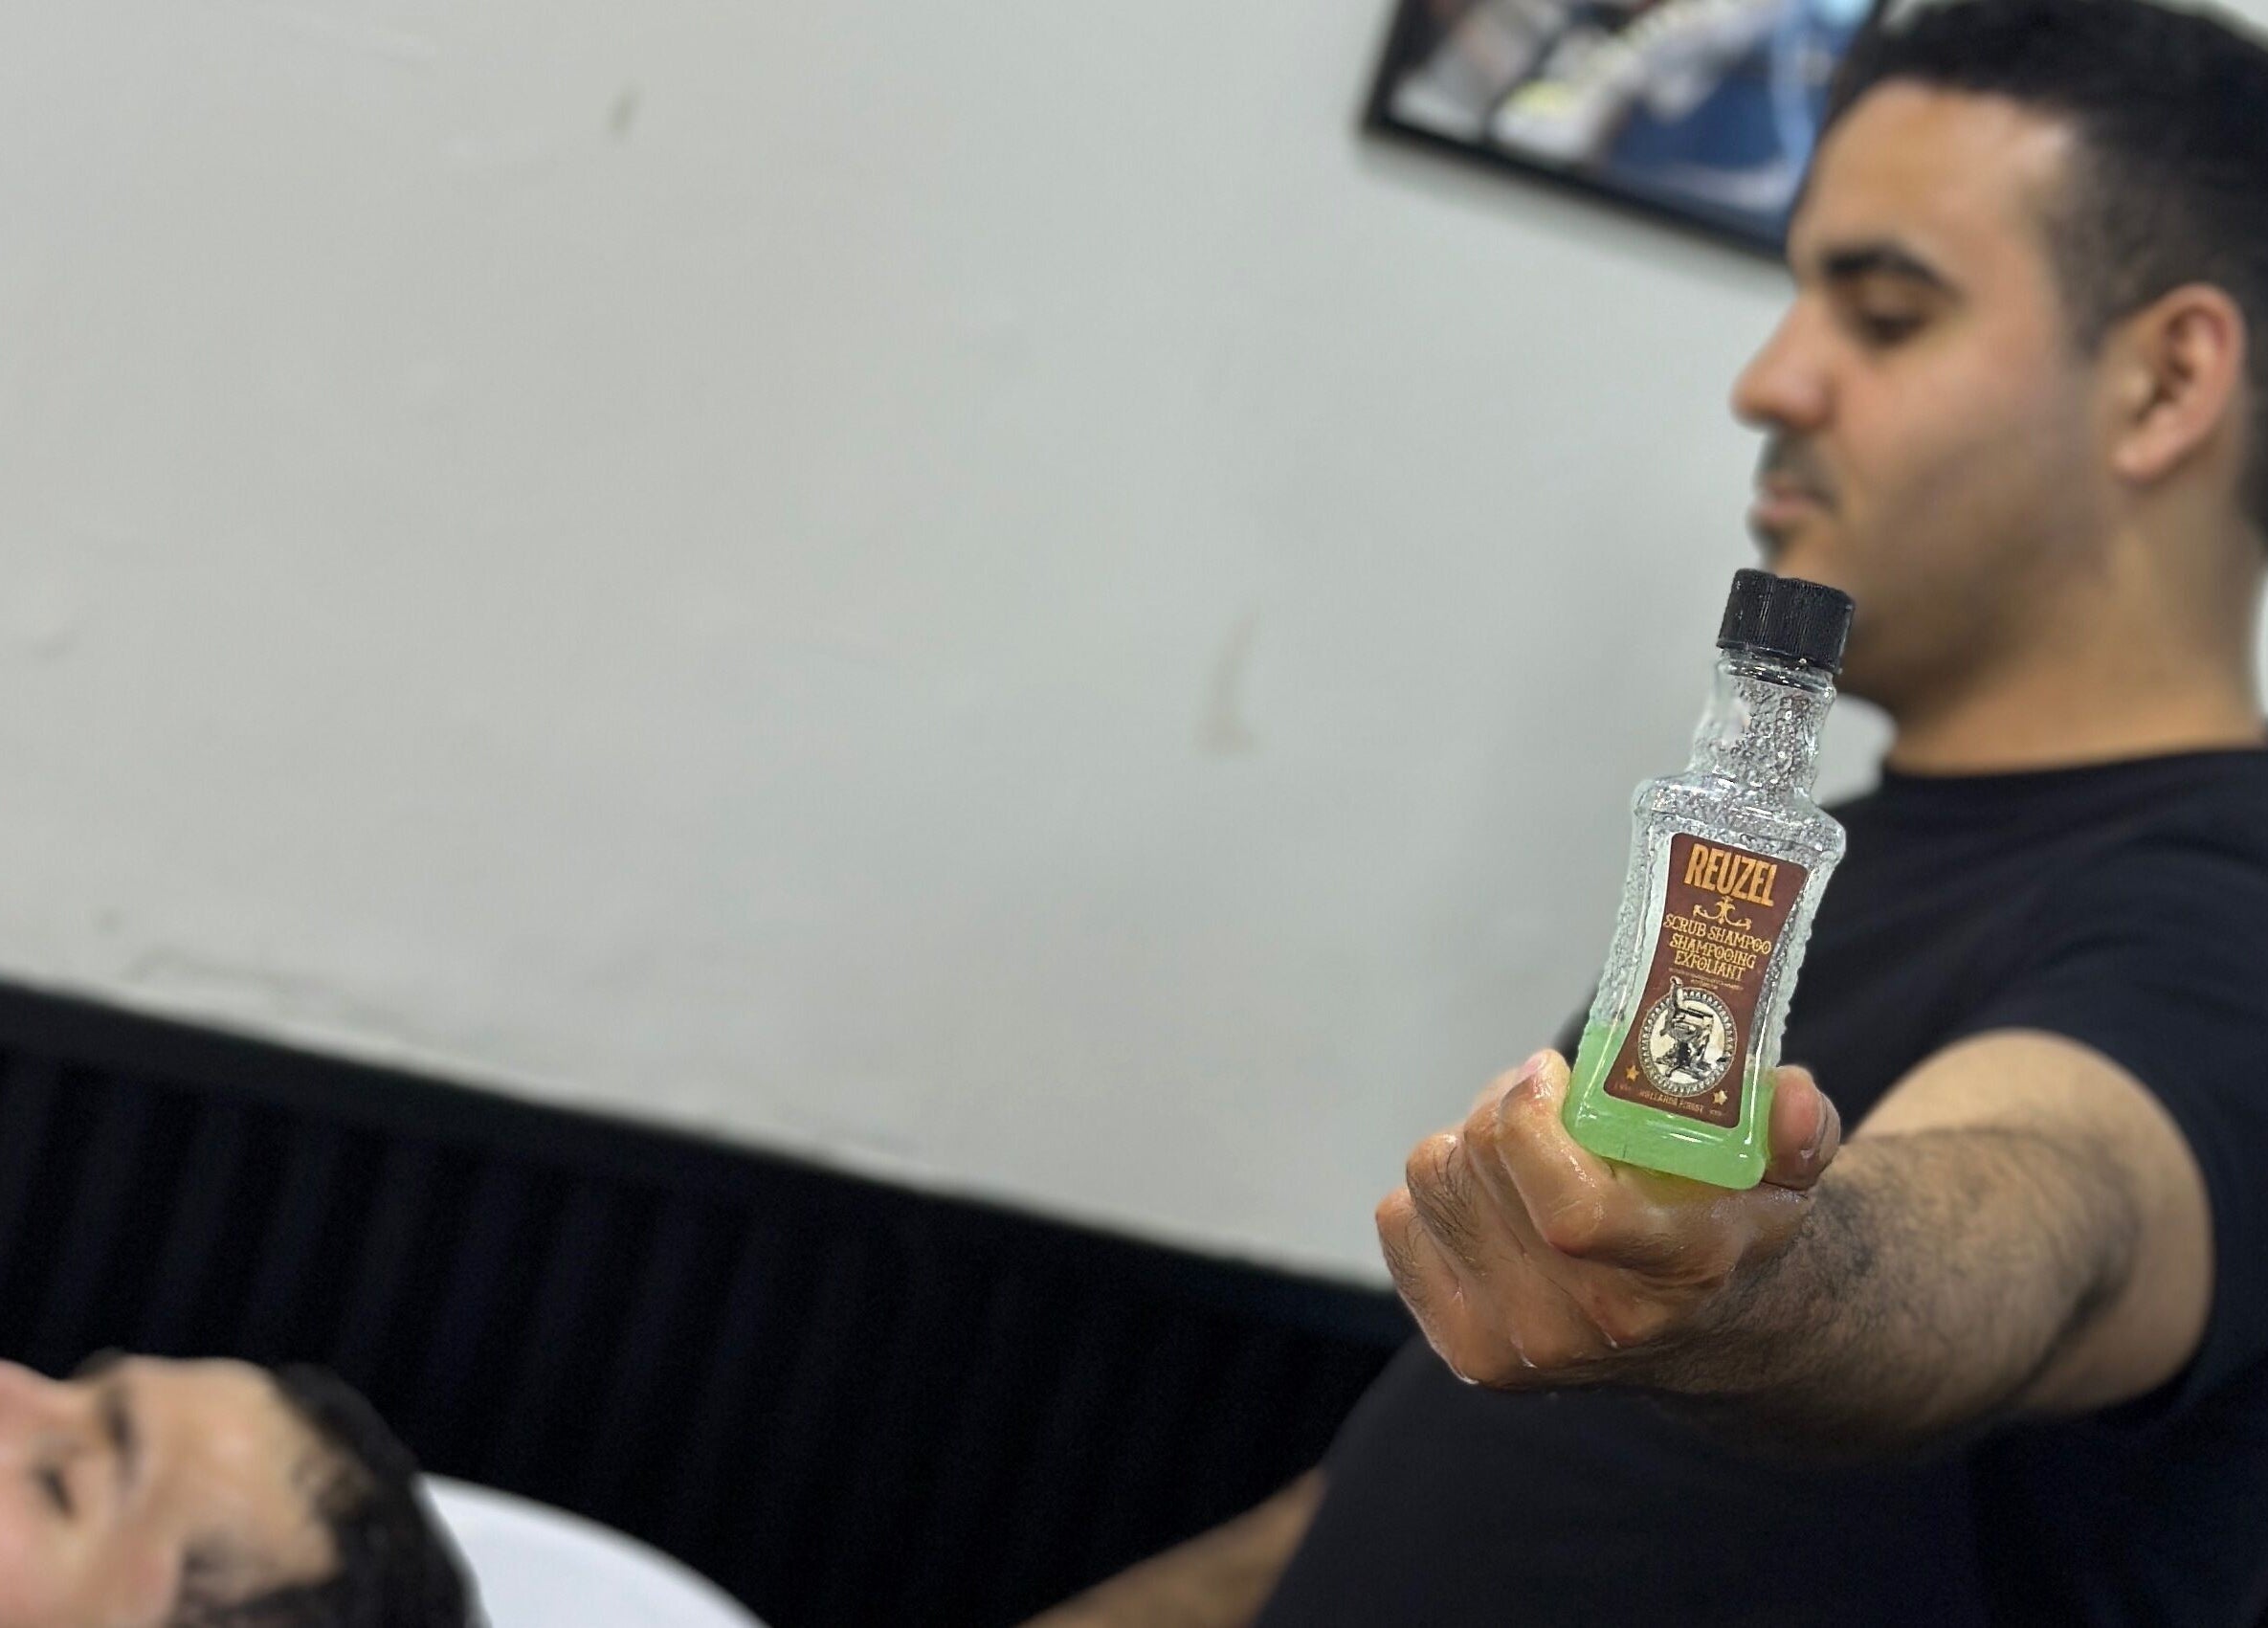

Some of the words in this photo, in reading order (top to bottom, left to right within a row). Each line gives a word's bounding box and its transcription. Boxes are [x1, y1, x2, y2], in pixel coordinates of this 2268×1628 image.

[1683, 842, 1777, 907] REUZEL
[1663, 913, 1707, 937] SCRUB
[1707, 926, 1771, 955] SHAMPOO
[1669, 932, 1757, 970] SHAMPOOING
[1674, 949, 1746, 979] EXFOLIANT
